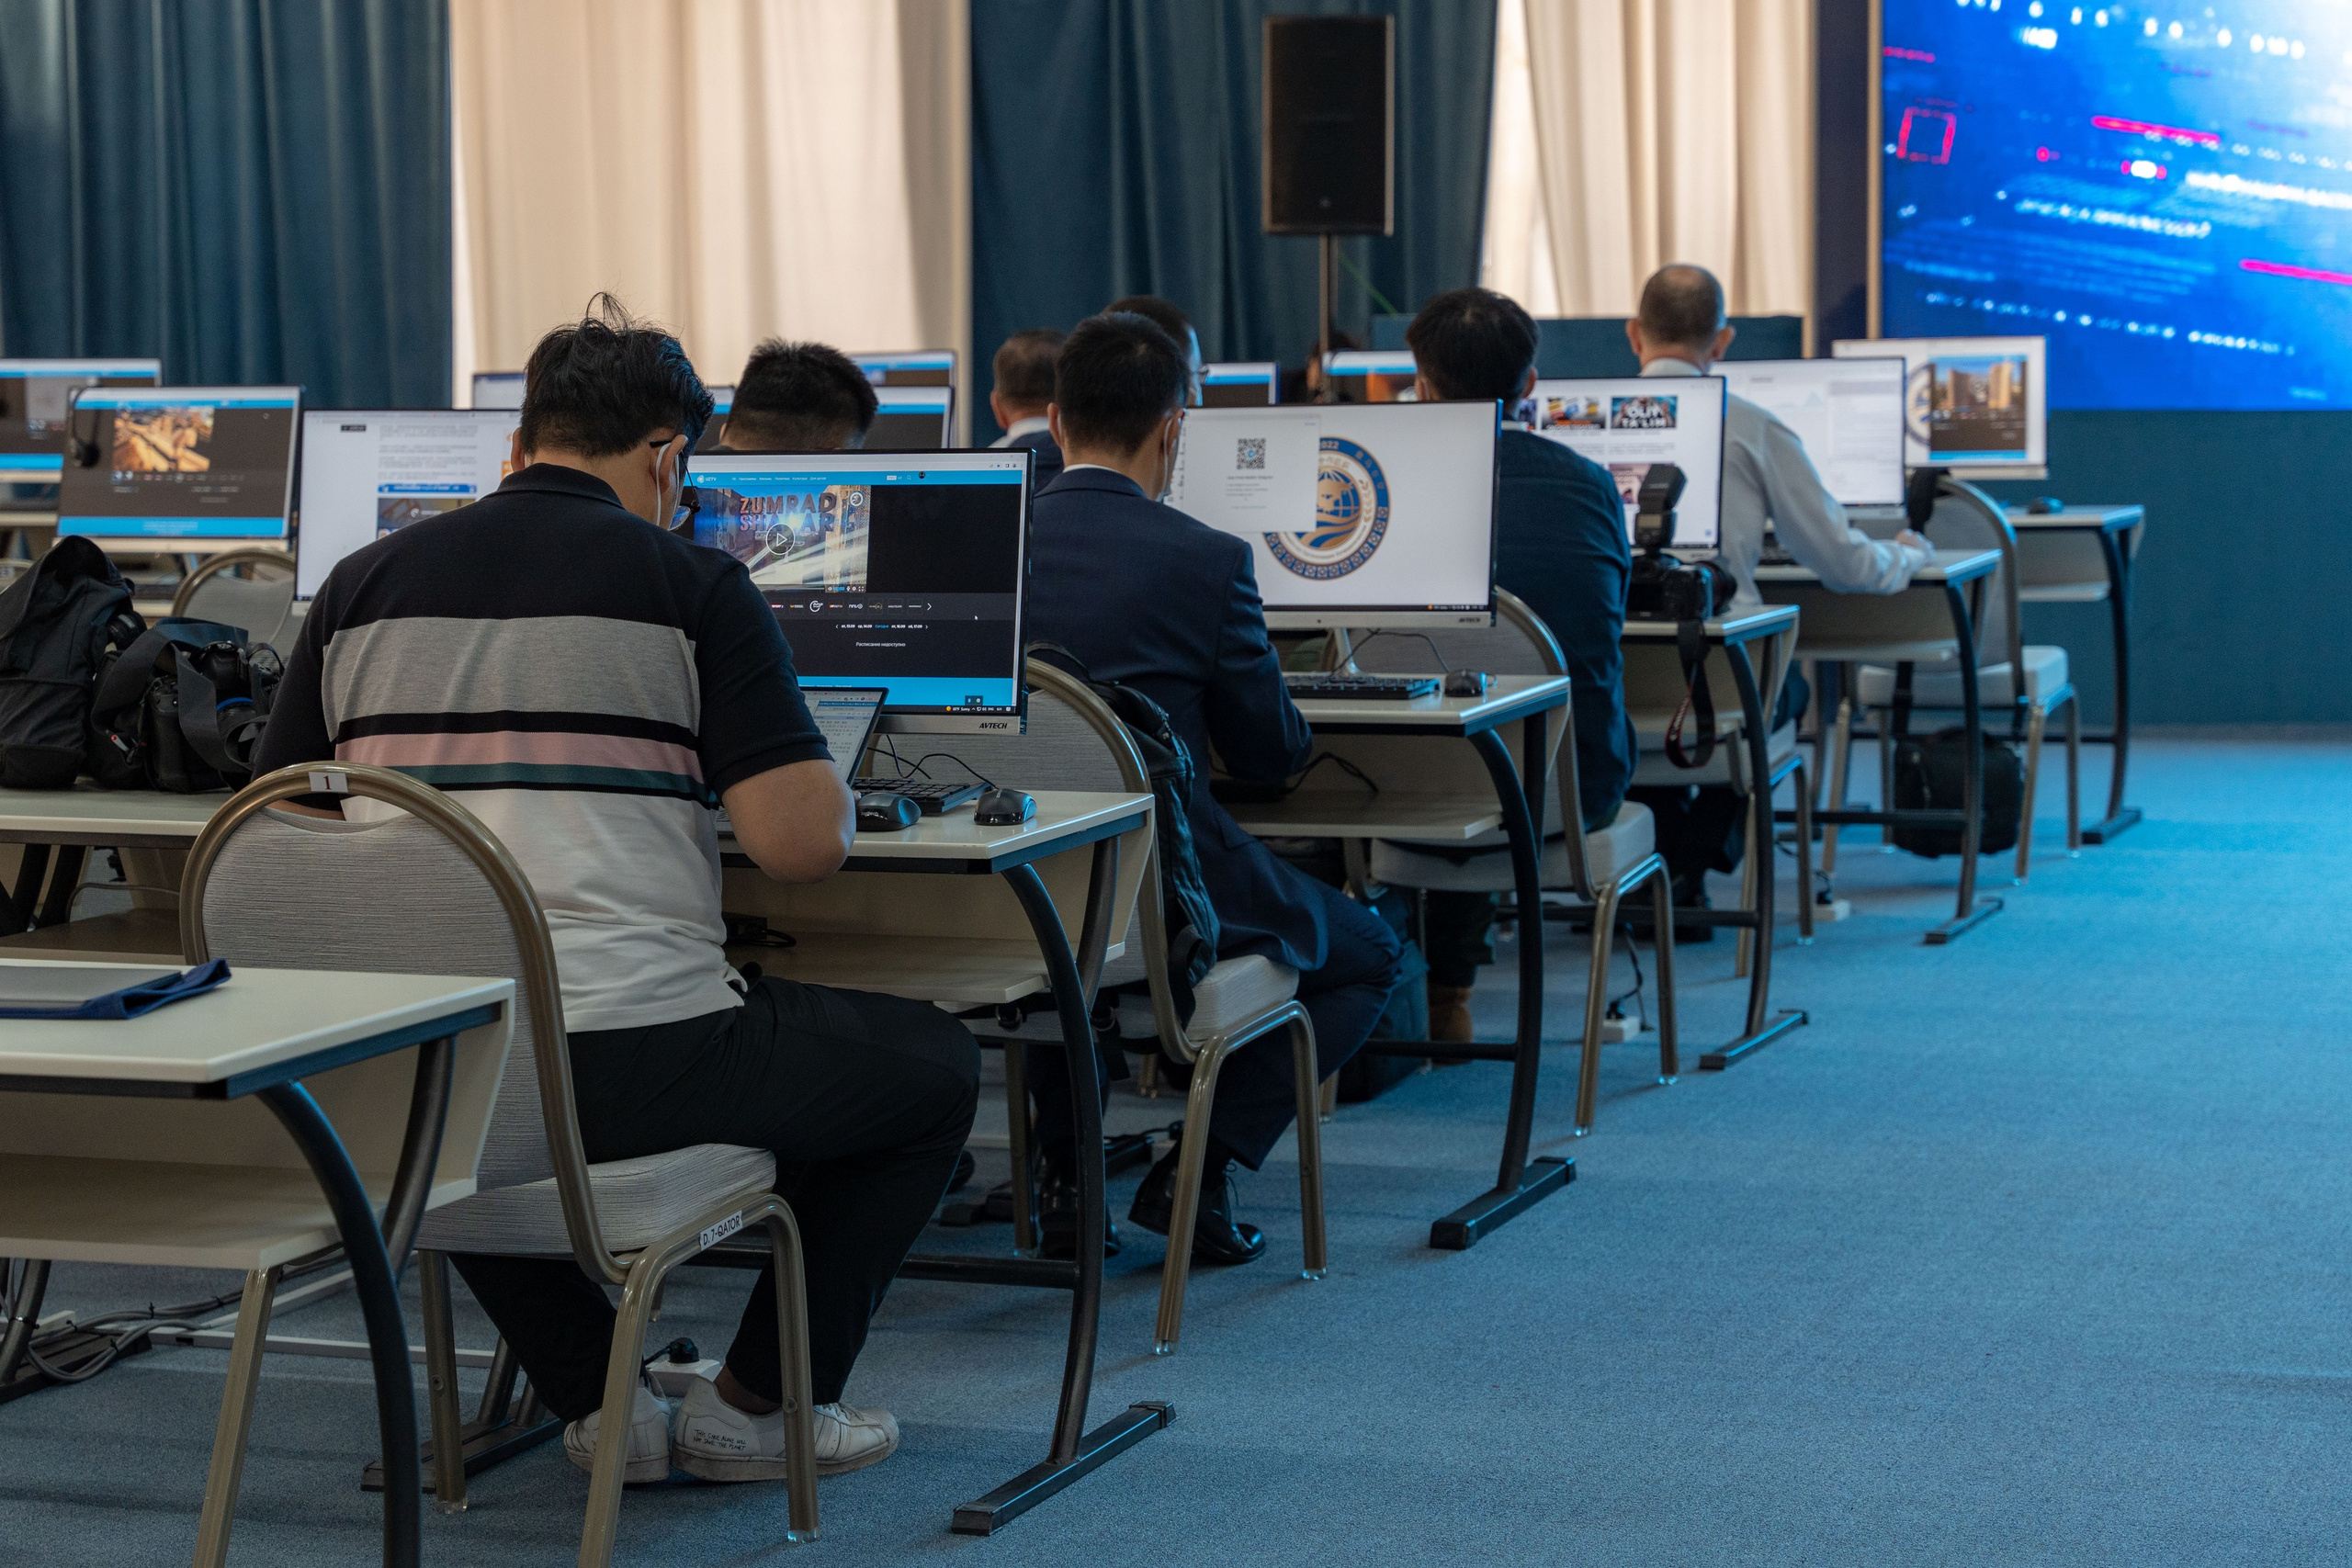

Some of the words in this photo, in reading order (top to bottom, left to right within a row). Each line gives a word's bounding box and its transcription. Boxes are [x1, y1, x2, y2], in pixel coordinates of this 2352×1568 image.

[740, 492, 837, 514] ZUMRAD
[323, 775, 332, 790] 1
[703, 1234, 710, 1246] D.
[711, 1215, 741, 1241] 7-QATOR
